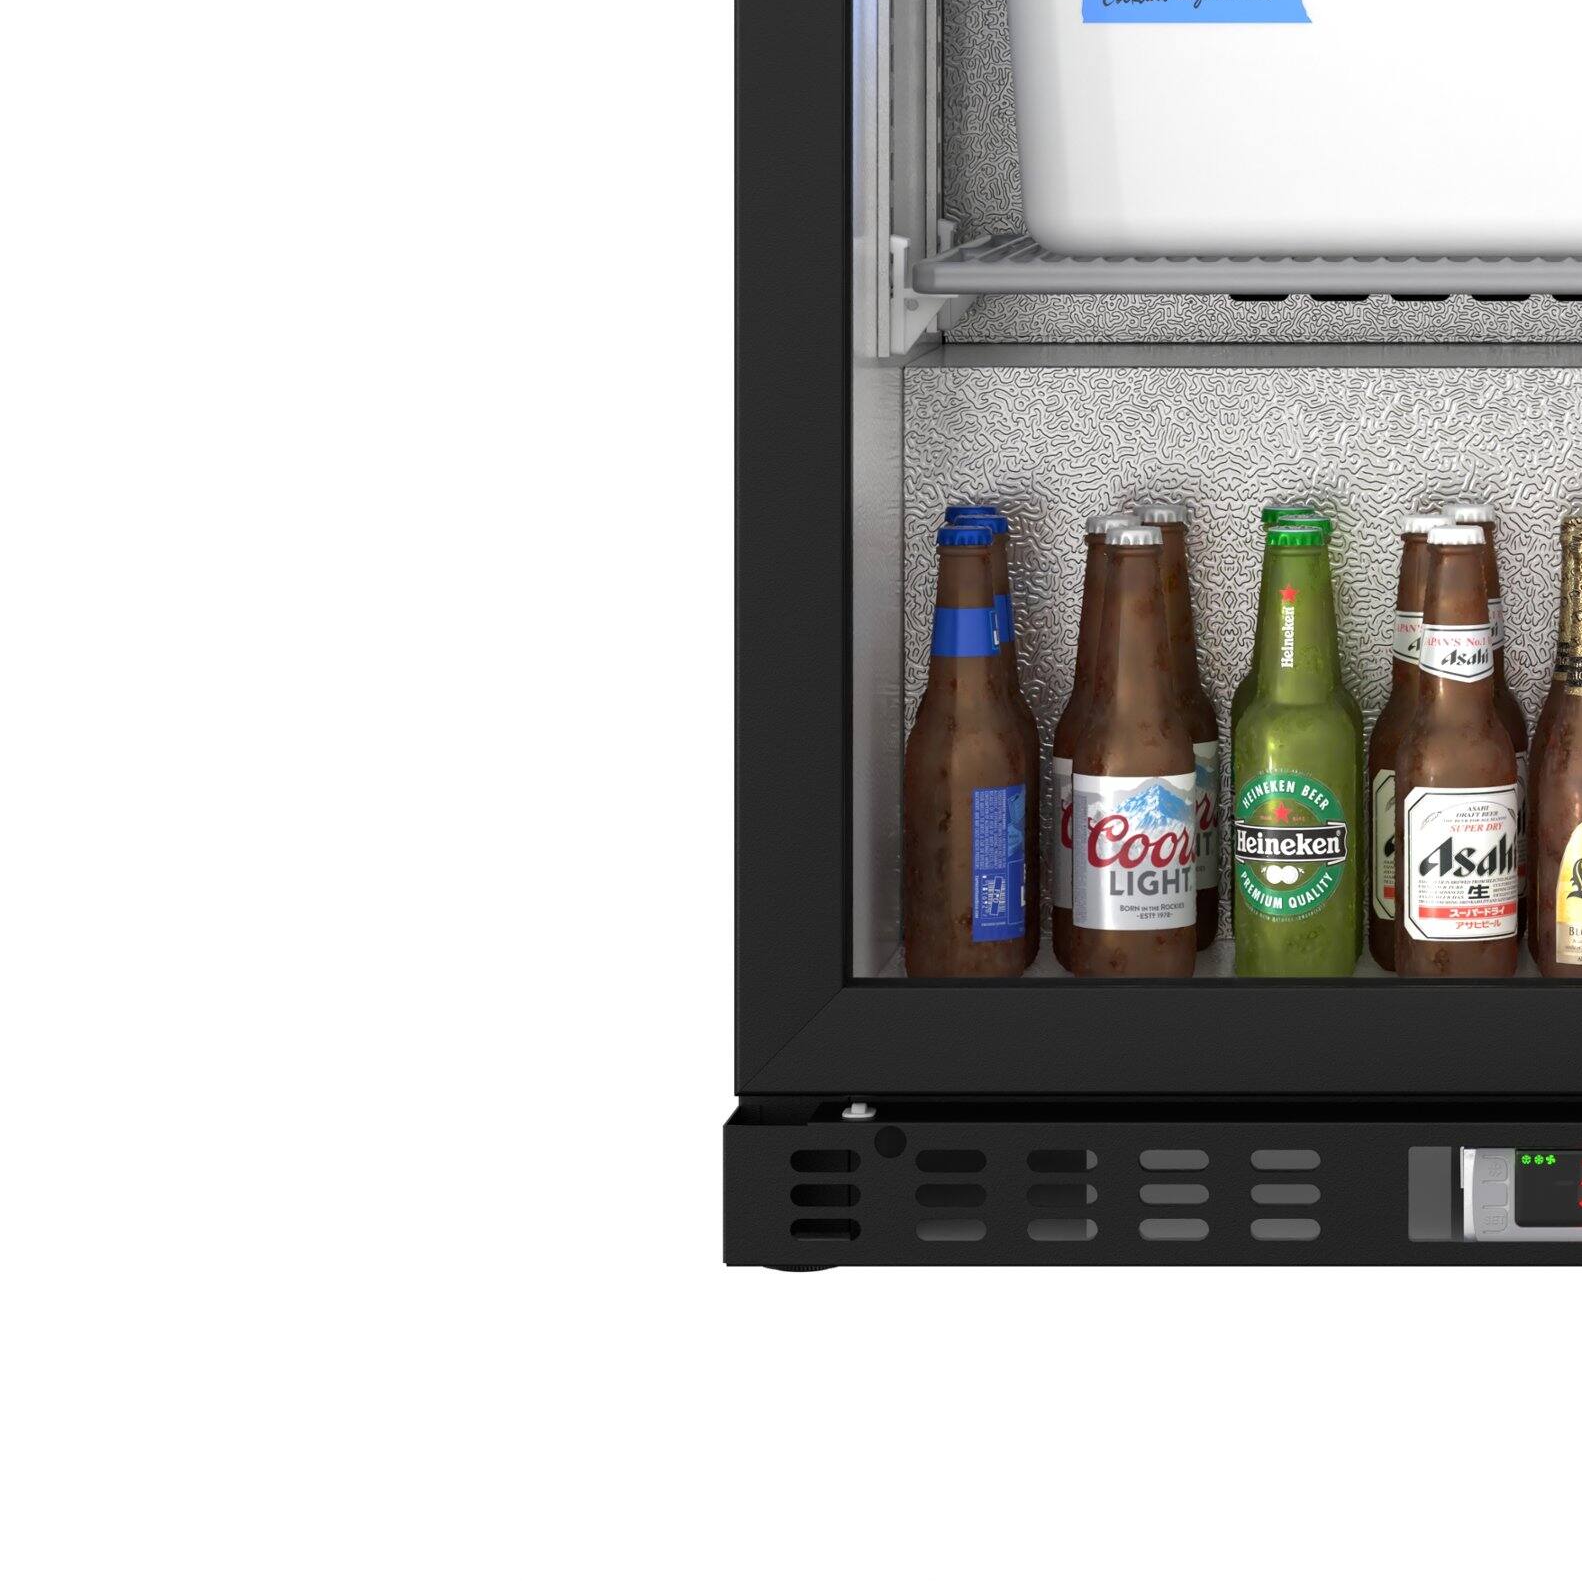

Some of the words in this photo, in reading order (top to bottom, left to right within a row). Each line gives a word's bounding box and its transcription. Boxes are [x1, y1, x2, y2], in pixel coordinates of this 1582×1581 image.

[1281, 605, 1295, 668] Heineken
[1441, 648, 1489, 665] Asahi
[1242, 779, 1296, 809] HEINEKEN
[1301, 784, 1330, 810] BEER
[1450, 824, 1484, 832] SUPER
[1486, 822, 1504, 831] DRY
[1237, 829, 1341, 856] Heineken
[1109, 868, 1191, 896] LIGHT
[1240, 870, 1283, 909] PREMIUM
[1288, 871, 1333, 909] QUALITY
[1467, 884, 1490, 900] 生
[1119, 904, 1140, 912] BORN
[1450, 906, 1505, 917] スーパードライ
[1455, 920, 1502, 930] アサヒビール
